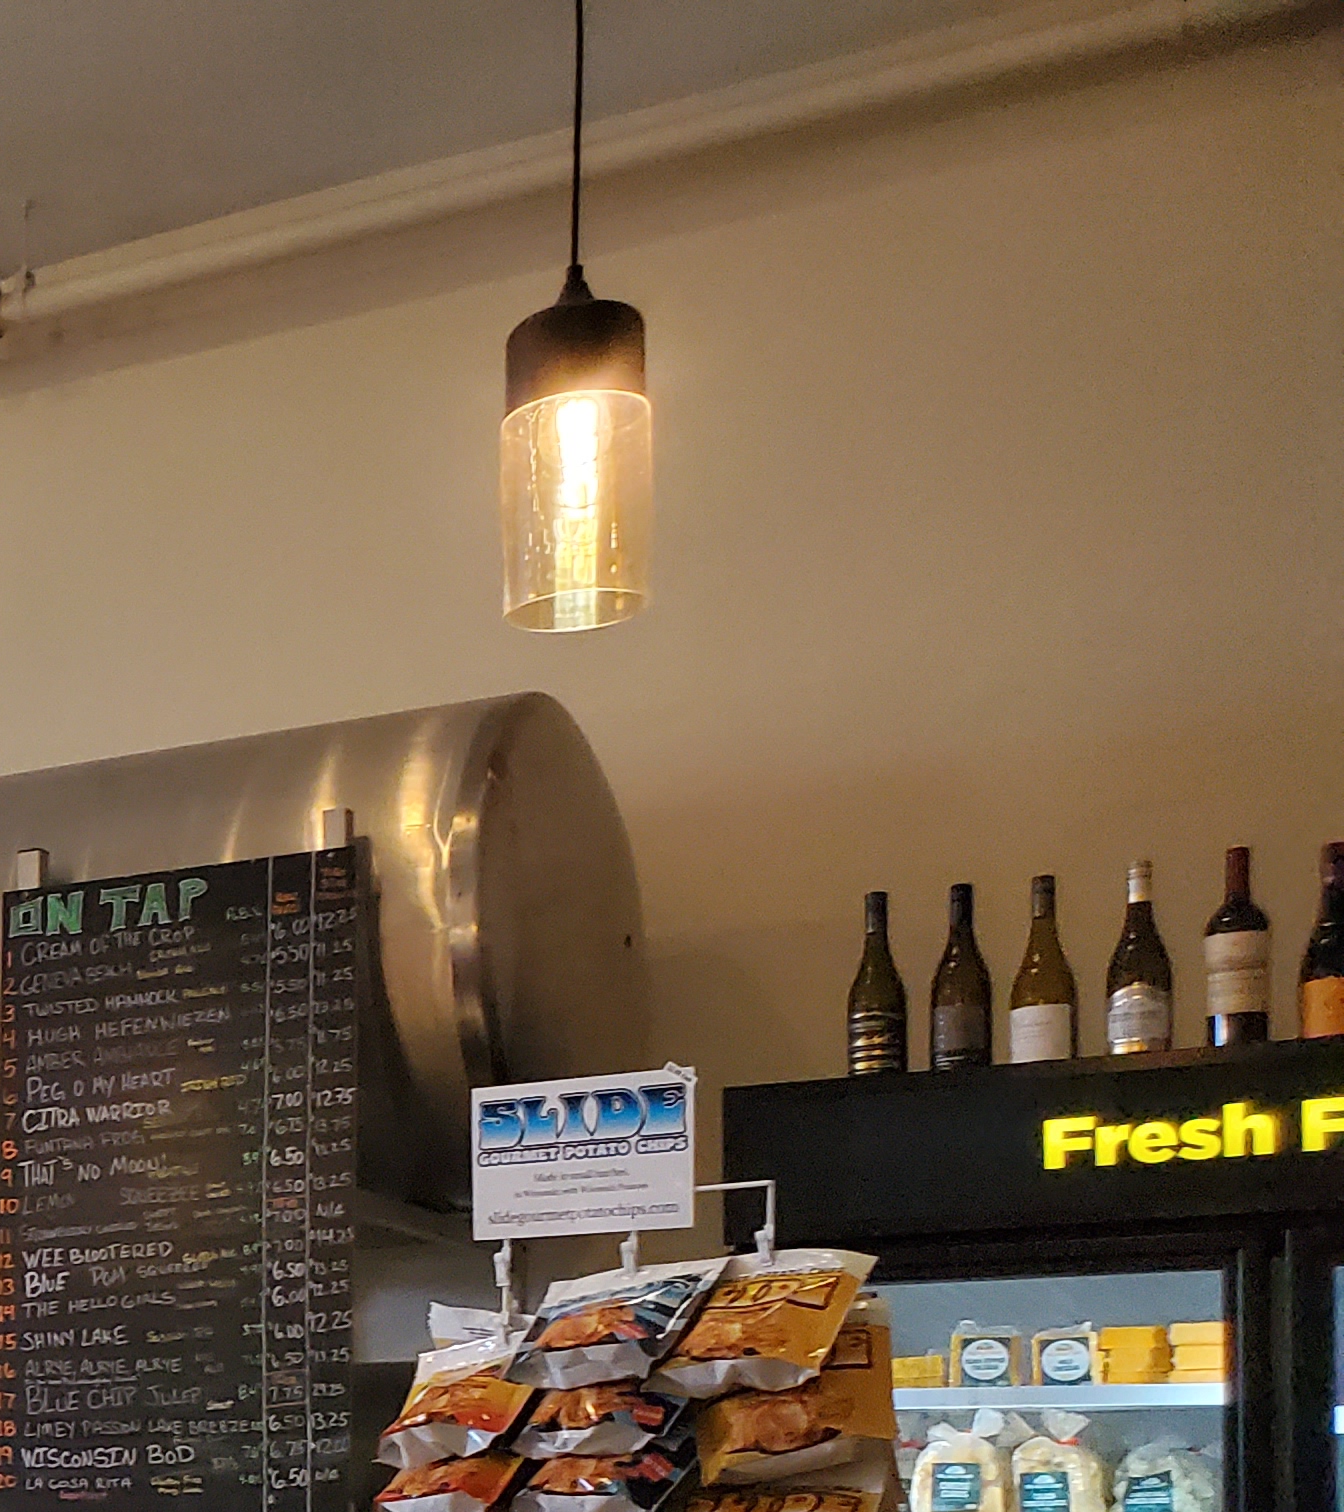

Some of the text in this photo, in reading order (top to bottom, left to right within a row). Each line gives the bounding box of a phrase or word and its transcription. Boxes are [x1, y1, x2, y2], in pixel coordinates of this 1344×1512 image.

[8, 877, 209, 938] ON TAP
[5, 926, 196, 969] 1 CREAM OF THE CROP
[2, 977, 18, 995] 2
[2, 1004, 16, 1022] 3
[22, 998, 100, 1018] TWISTED
[104, 988, 179, 1010] HAMMOCK
[2, 1030, 16, 1049] 4
[27, 1025, 81, 1048] HUGH
[3, 1058, 18, 1078] 5
[26, 1076, 66, 1103] PEG
[92, 1075, 116, 1097] MY
[121, 1067, 177, 1091] HEART
[3, 1112, 16, 1131] 7
[21, 1107, 80, 1134] CITRA
[86, 1099, 174, 1124] WARRIOR
[1043, 1102, 1276, 1170] Fresh
[1, 1140, 18, 1160] 8
[478, 1135, 689, 1167] GOURMET POTATO CHIPS
[0, 1168, 13, 1187] 9
[77, 1162, 101, 1182] NO
[0, 1197, 19, 1215] 10
[0, 1228, 11, 1245] 11
[21, 1246, 65, 1271] WEE
[20, 1299, 60, 1319] THE
[68, 1294, 118, 1314] HELLO
[20, 1329, 76, 1352] SHINY
[80, 1324, 131, 1348] LAKE
[23, 1384, 81, 1415] BLUE
[87, 1385, 139, 1410] CHIP
[23, 1420, 77, 1439] LIMEY
[21, 1445, 137, 1469] WISCONSIN
[25, 1477, 44, 1490] LA
[48, 1476, 89, 1490] COSA
[94, 1475, 133, 1489] RITA
